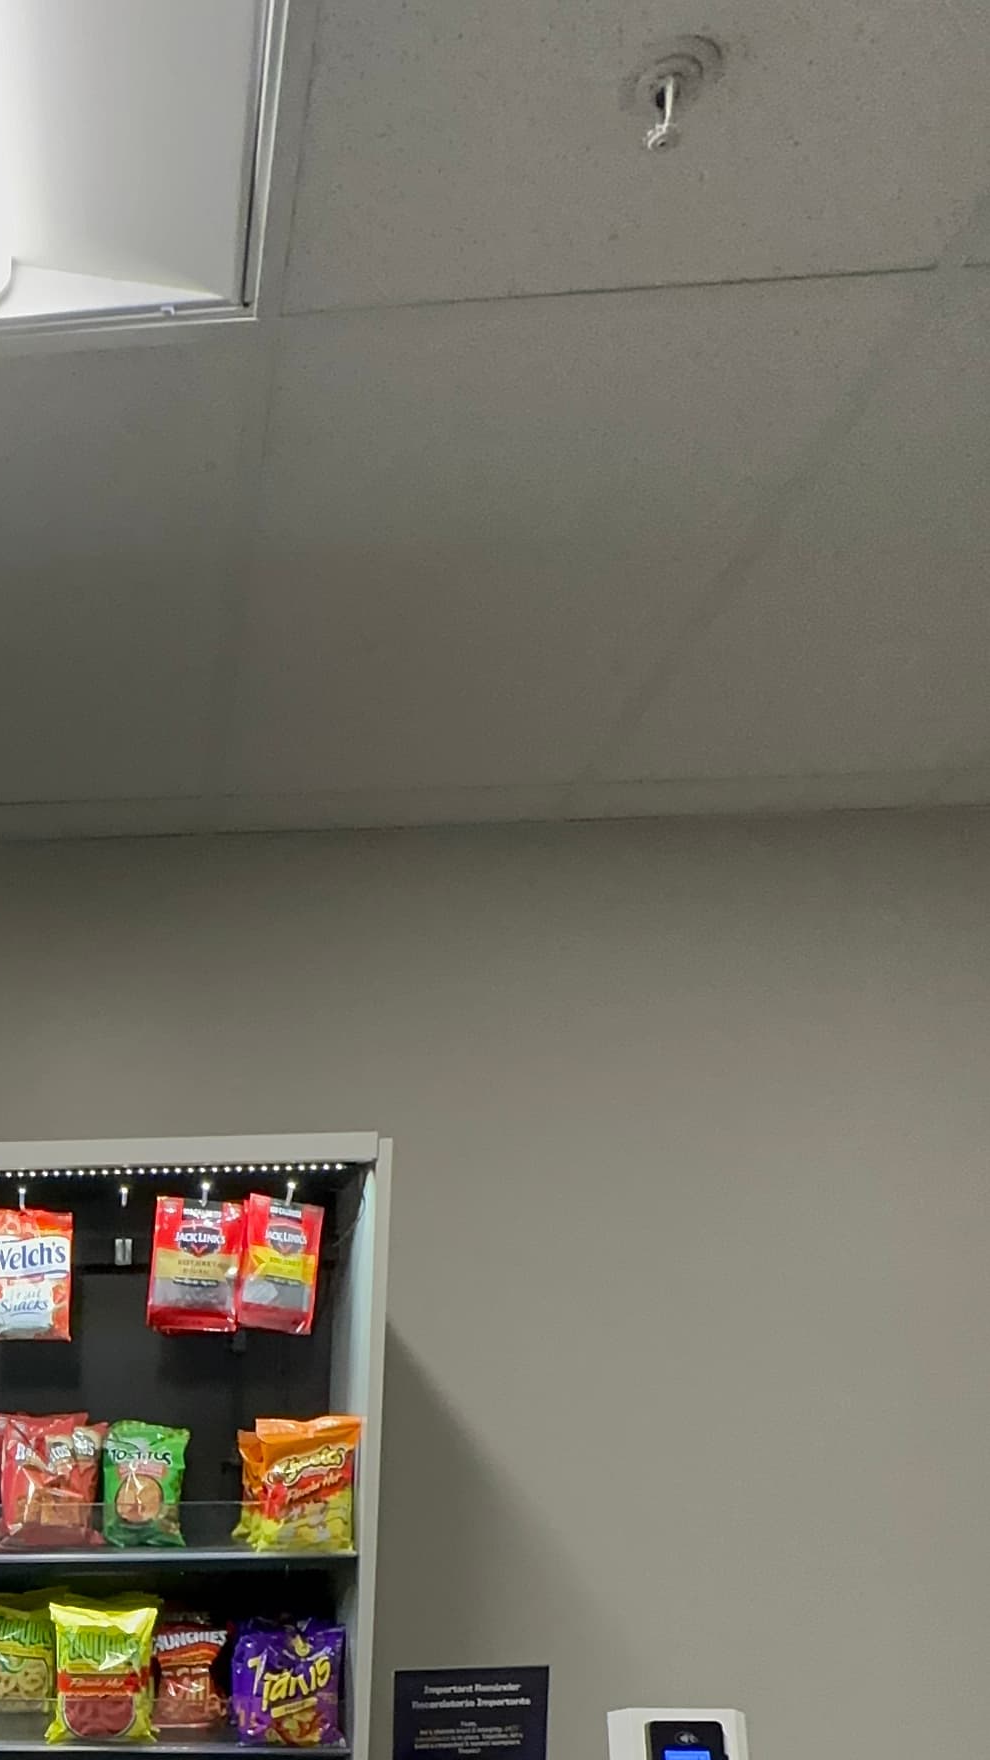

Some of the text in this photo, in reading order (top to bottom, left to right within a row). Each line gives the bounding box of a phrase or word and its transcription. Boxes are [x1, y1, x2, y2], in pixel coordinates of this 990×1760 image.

[423, 1682, 521, 1695] Important Reminder
[476, 1697, 531, 1708] Importante
